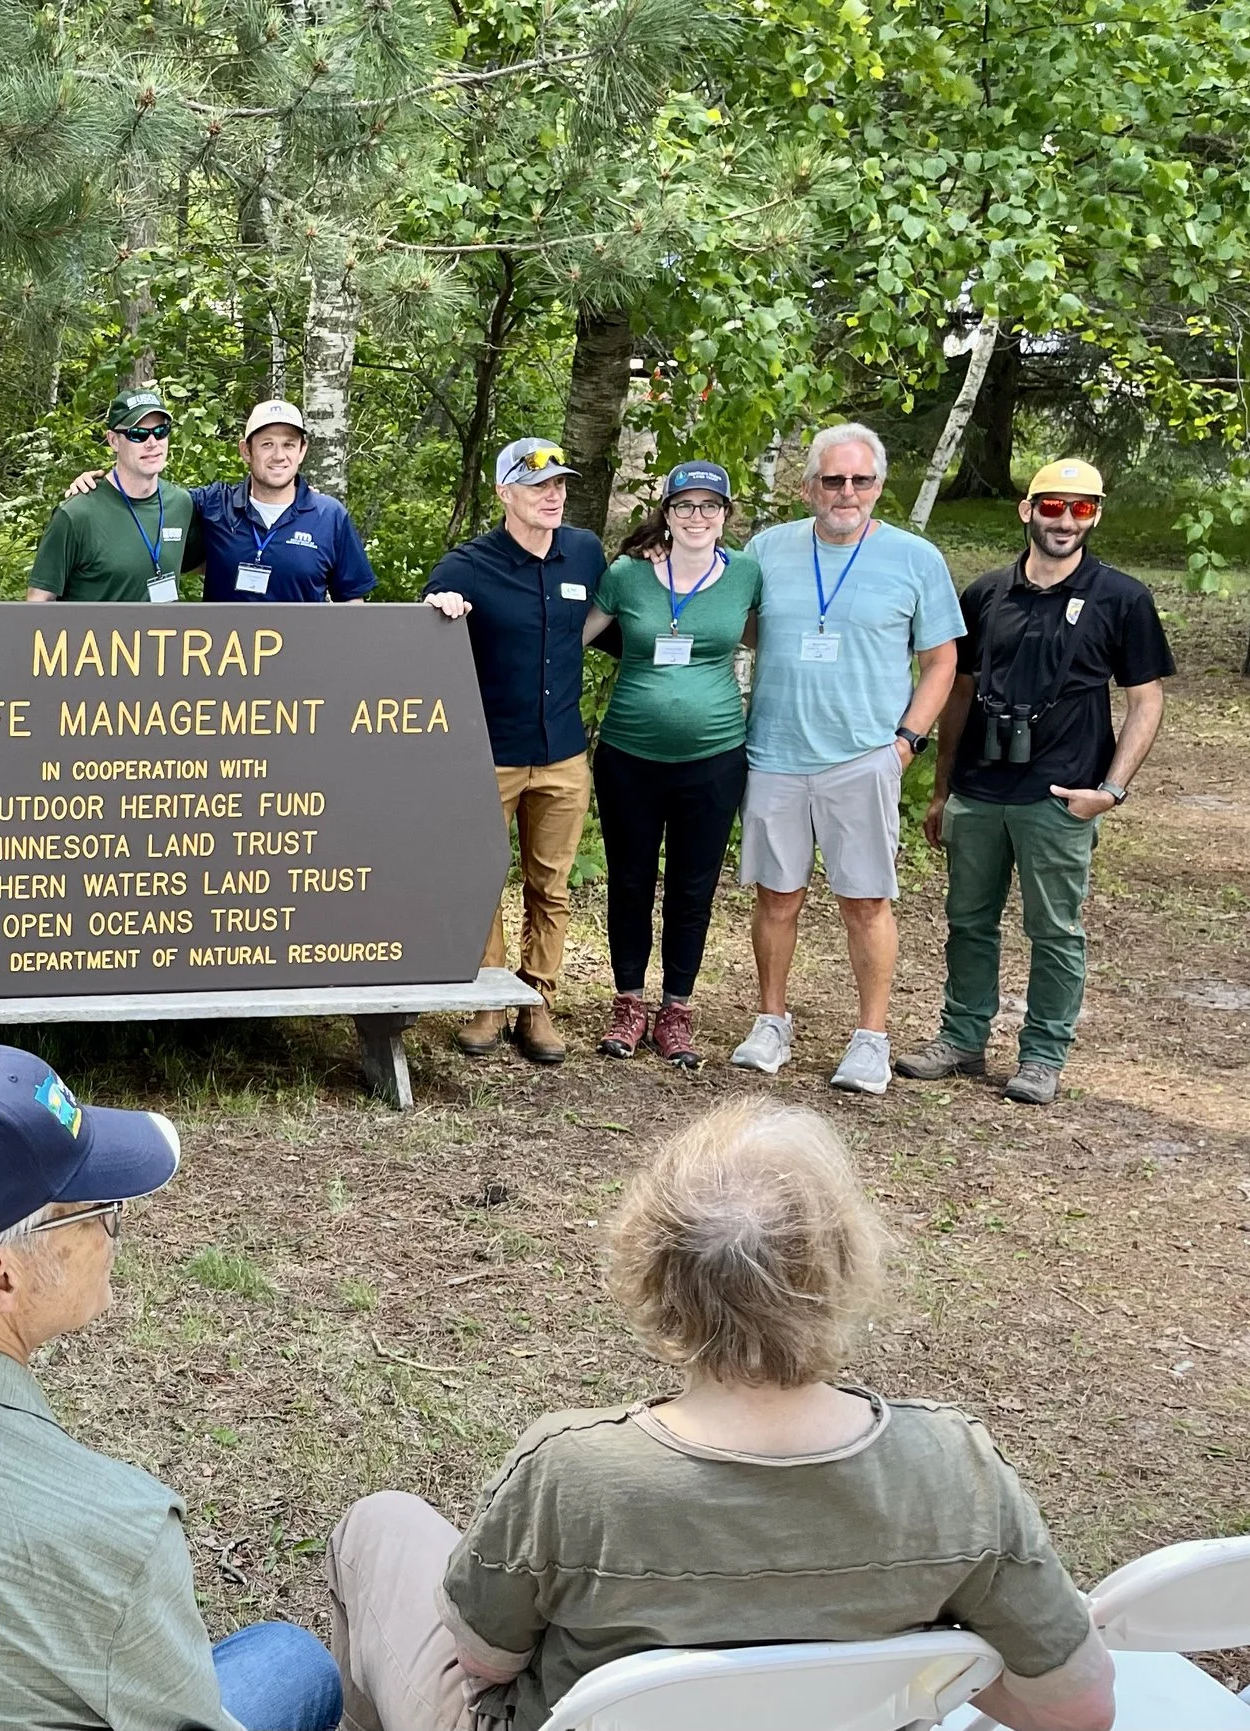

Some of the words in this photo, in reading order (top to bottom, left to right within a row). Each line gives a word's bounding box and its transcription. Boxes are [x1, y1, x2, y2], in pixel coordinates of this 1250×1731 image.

[32, 629, 284, 677] MANTRAP
[59, 699, 324, 737] MANAGEMENT
[350, 698, 449, 734] AREA
[41, 761, 61, 782] IN
[72, 759, 208, 781] COOPERATION
[219, 759, 268, 779] WITH
[120, 792, 243, 819] HERITAGE
[259, 792, 326, 817] FUND
[147, 832, 216, 858] LAND
[232, 830, 318, 855] TRUST
[82, 871, 188, 897] WATERS
[203, 869, 271, 896] LAND
[288, 866, 373, 894] TRUST
[2, 912, 73, 938] OPEN
[88, 910, 194, 936] OCEANS
[211, 906, 296, 933] TRUST
[10, 948, 139, 972] DEPARTMENT
[152, 947, 177, 969] OF
[189, 945, 276, 967] NATURAL
[287, 942, 404, 964] RESOURCES
